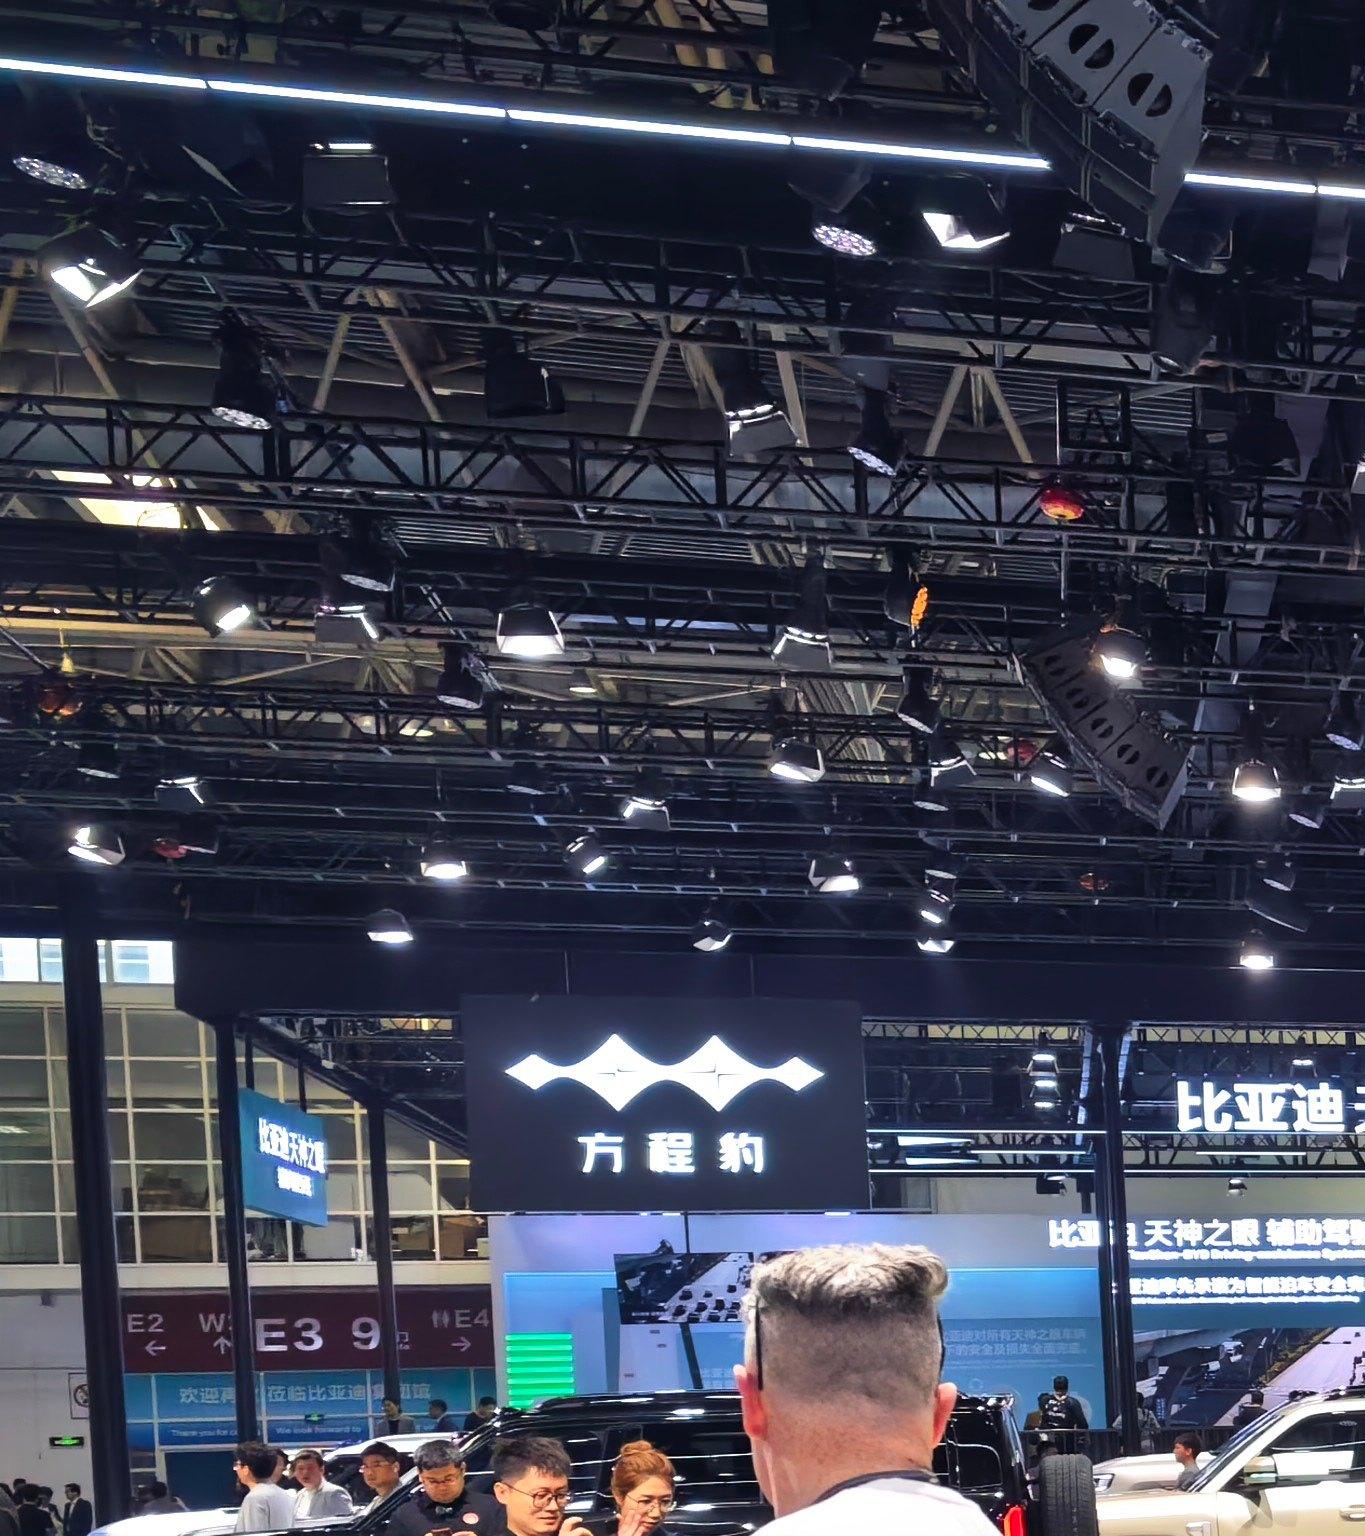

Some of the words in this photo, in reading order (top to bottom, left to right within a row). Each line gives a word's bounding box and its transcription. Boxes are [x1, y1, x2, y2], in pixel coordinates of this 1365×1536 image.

[1176, 1080, 1346, 1132] 比亚迪
[577, 1131, 765, 1174] 方程豹
[1143, 1218, 1260, 1247] 天神之眼
[126, 1313, 164, 1333] E2
[199, 1313, 232, 1333] W
[455, 1309, 489, 1329] E4
[256, 1317, 324, 1352] E3
[352, 1316, 380, 1350] 9
